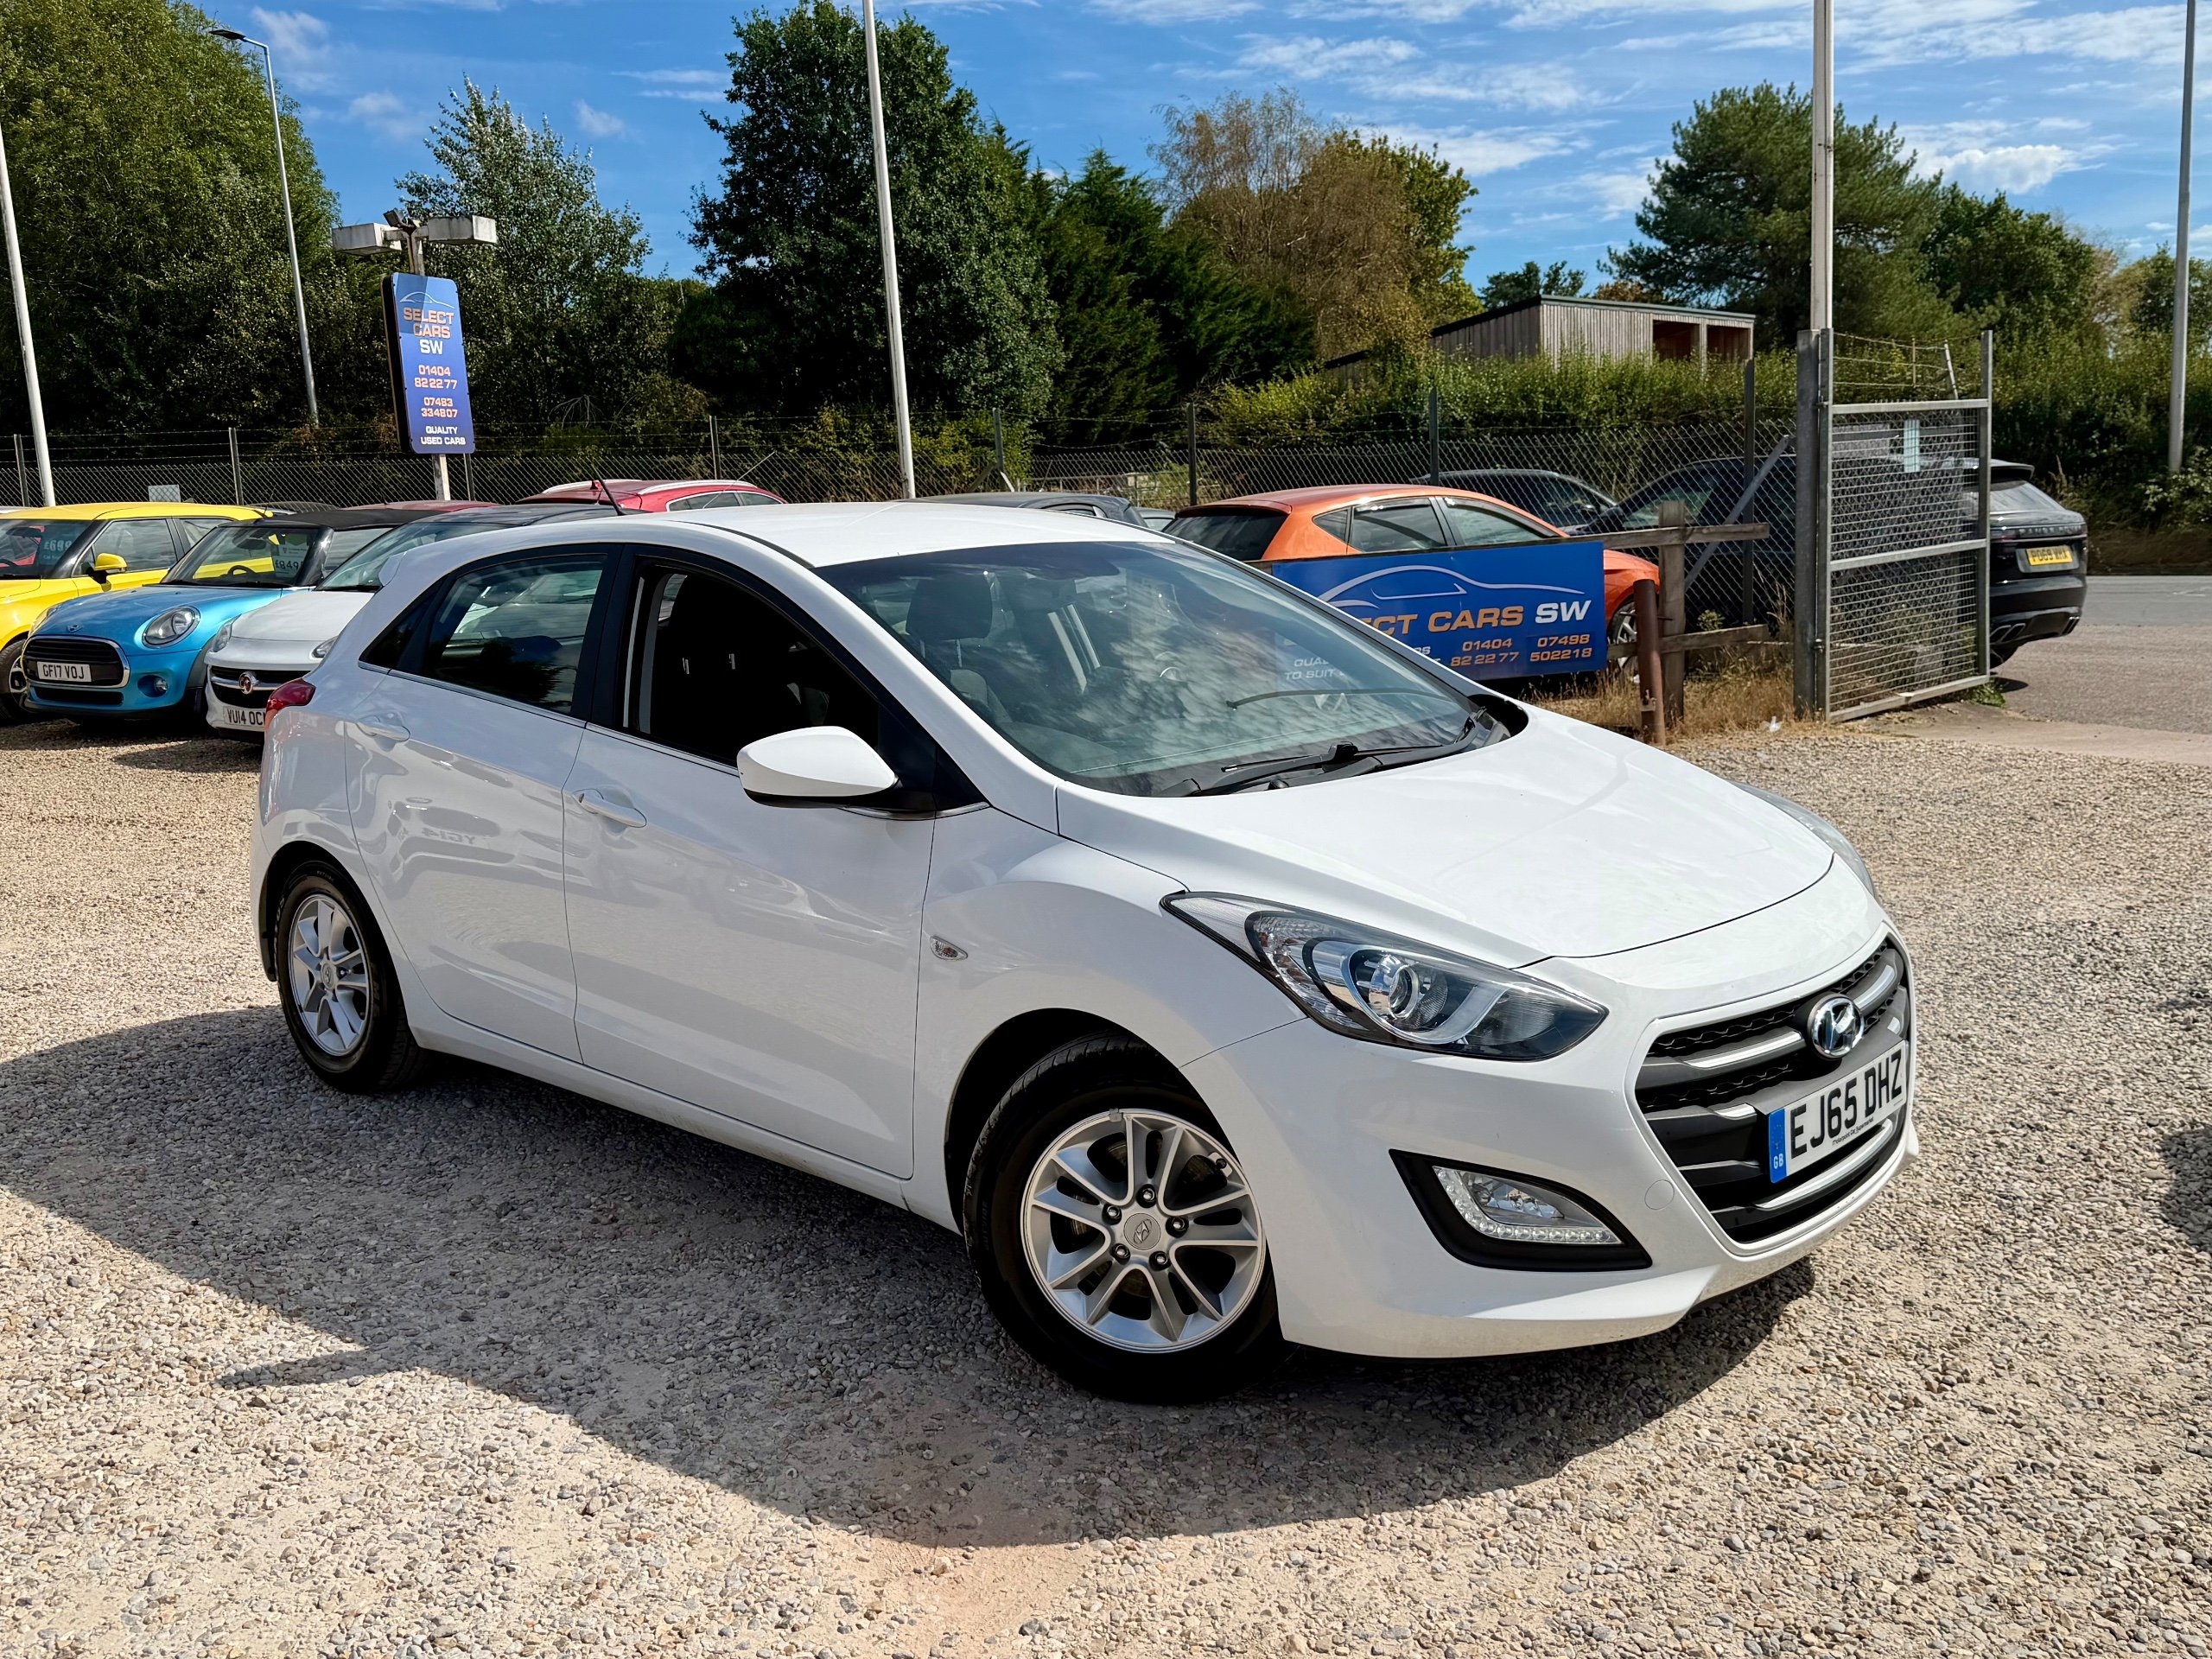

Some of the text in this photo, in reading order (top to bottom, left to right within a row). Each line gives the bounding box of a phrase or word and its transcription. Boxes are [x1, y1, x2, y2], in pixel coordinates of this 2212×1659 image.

[404, 307, 454, 325] SELECT
[413, 323, 450, 339] CARS
[419, 339, 443, 355] SW
[418, 365, 451, 376] 01404
[425, 425, 457, 434] QUALITY
[420, 436, 442, 445] USED
[275, 559, 303, 570] £849
[1427, 606, 1524, 632] CARS
[1535, 600, 1592, 624] SW
[1462, 638, 1513, 652] 01404
[1537, 633, 1591, 648] 07498
[1294, 657, 1330, 666] QUAL
[1529, 647, 1592, 662] 502218
[42, 664, 85, 679] GF17 VOJ
[1286, 669, 1336, 680] TO SUIT
[227, 708, 265, 725] VU14 OC
[1789, 1048, 1903, 1159] EJ65 DHZ
[1773, 1153, 1784, 1170] GB
